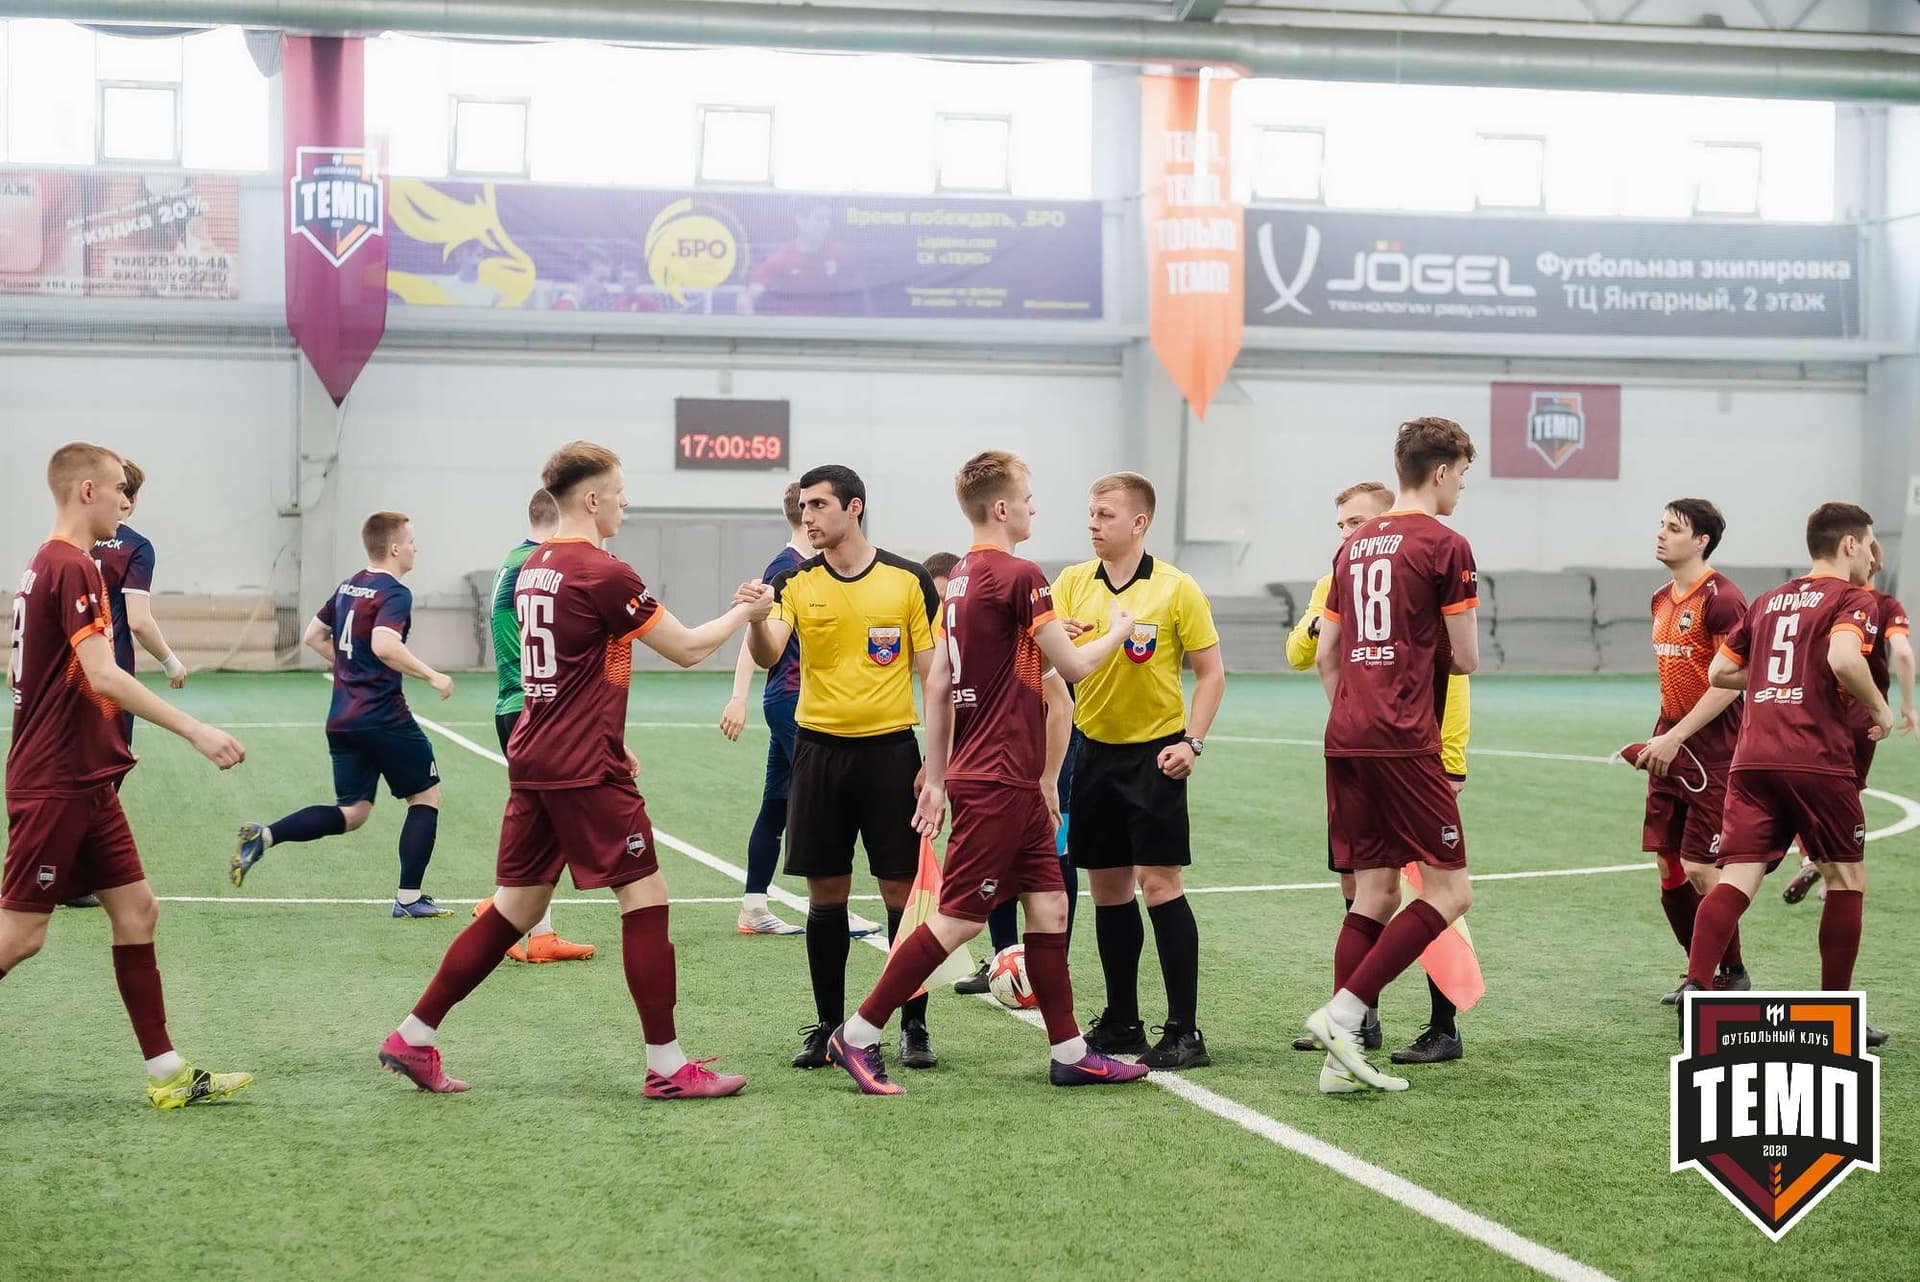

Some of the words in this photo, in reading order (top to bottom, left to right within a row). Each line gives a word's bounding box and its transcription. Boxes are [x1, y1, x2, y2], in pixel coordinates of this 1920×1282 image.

[158, 196, 209, 224] 20%
[300, 181, 374, 224] ТЕМП
[671, 238, 727, 260] .БРО
[1166, 261, 1230, 295] ТЕМП
[1326, 240, 1537, 297] JÖGEL
[1536, 252, 1694, 281] Футбольная
[1700, 258, 1850, 284] экипировка
[1563, 285, 1599, 314] ТЦ
[1604, 285, 1737, 316] Янтарный,
[1744, 287, 1757, 311] 2
[1765, 292, 1826, 312] этаж
[680, 434, 781, 460] 17:00:59
[1350, 534, 1404, 561] БРИЧЕЕВ
[1350, 558, 1392, 642] 18
[339, 609, 355, 660] 4
[516, 594, 557, 679] 25
[1767, 613, 1801, 684] 5
[1350, 646, 1396, 664] SEUS
[1754, 687, 1804, 704] SEUS
